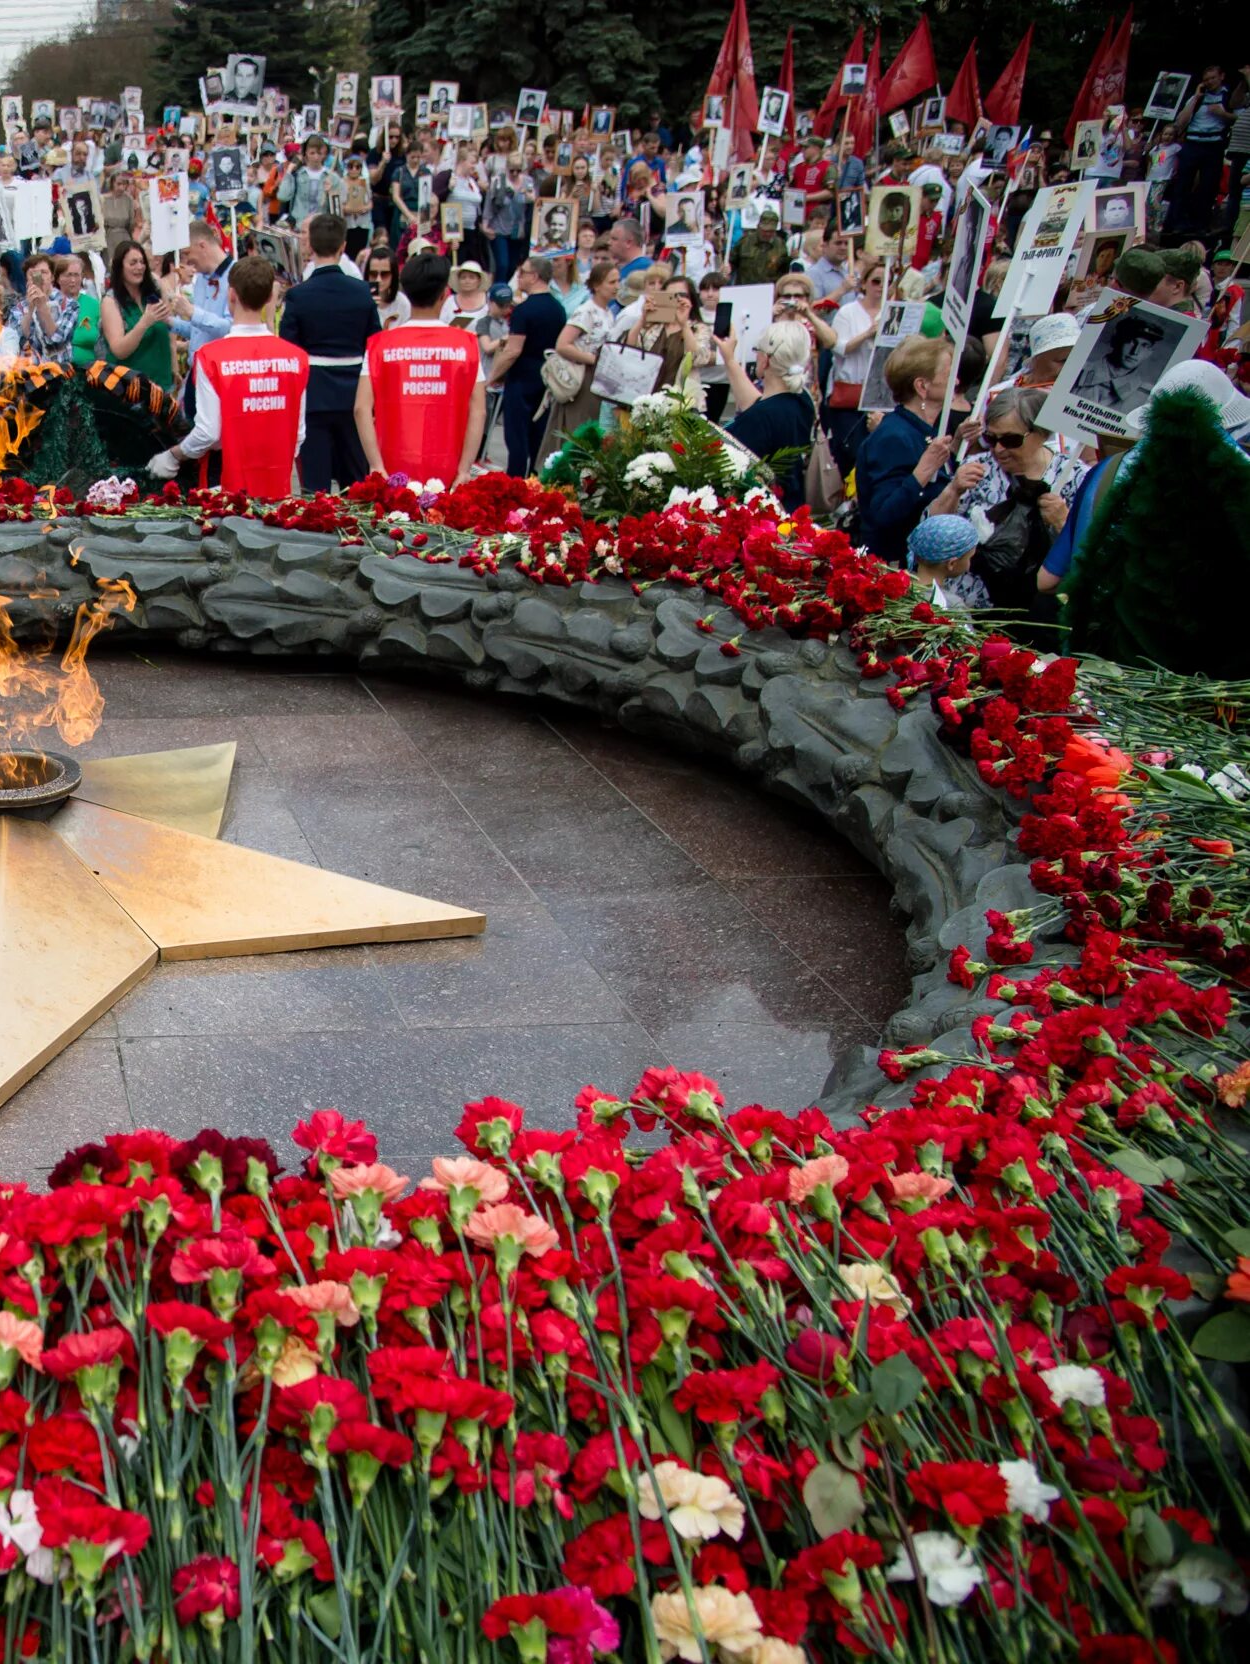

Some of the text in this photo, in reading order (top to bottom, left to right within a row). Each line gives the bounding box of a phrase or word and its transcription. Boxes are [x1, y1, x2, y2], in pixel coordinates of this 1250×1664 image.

[383, 346, 467, 362] БЕССМЕРТНЫЙ
[221, 356, 300, 376] БЕССМЕРТНЫЙ
[409, 364, 441, 378] ПОЛК
[249, 376, 280, 393] ПОЛК
[402, 381, 447, 395] РОССИИ
[242, 395, 287, 413] РОССИИ
[1076, 399, 1123, 423] Болдырев
[1062, 405, 1127, 436] Илья Иванович
